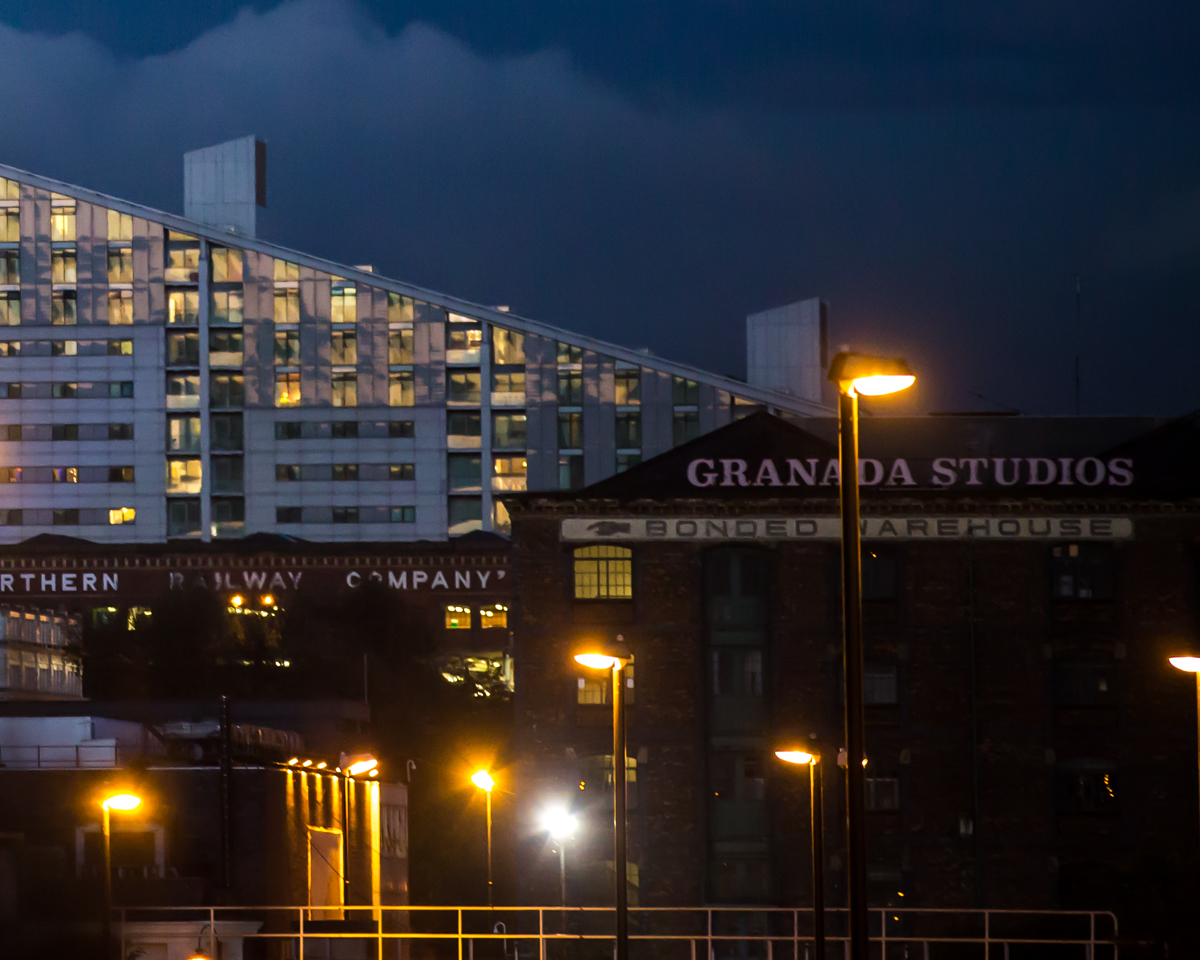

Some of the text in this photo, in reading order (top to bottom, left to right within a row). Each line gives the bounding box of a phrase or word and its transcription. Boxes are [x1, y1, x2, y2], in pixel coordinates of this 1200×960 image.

[686, 456, 1135, 488] GRANADA STUDIOS
[645, 519, 818, 538] BONDED
